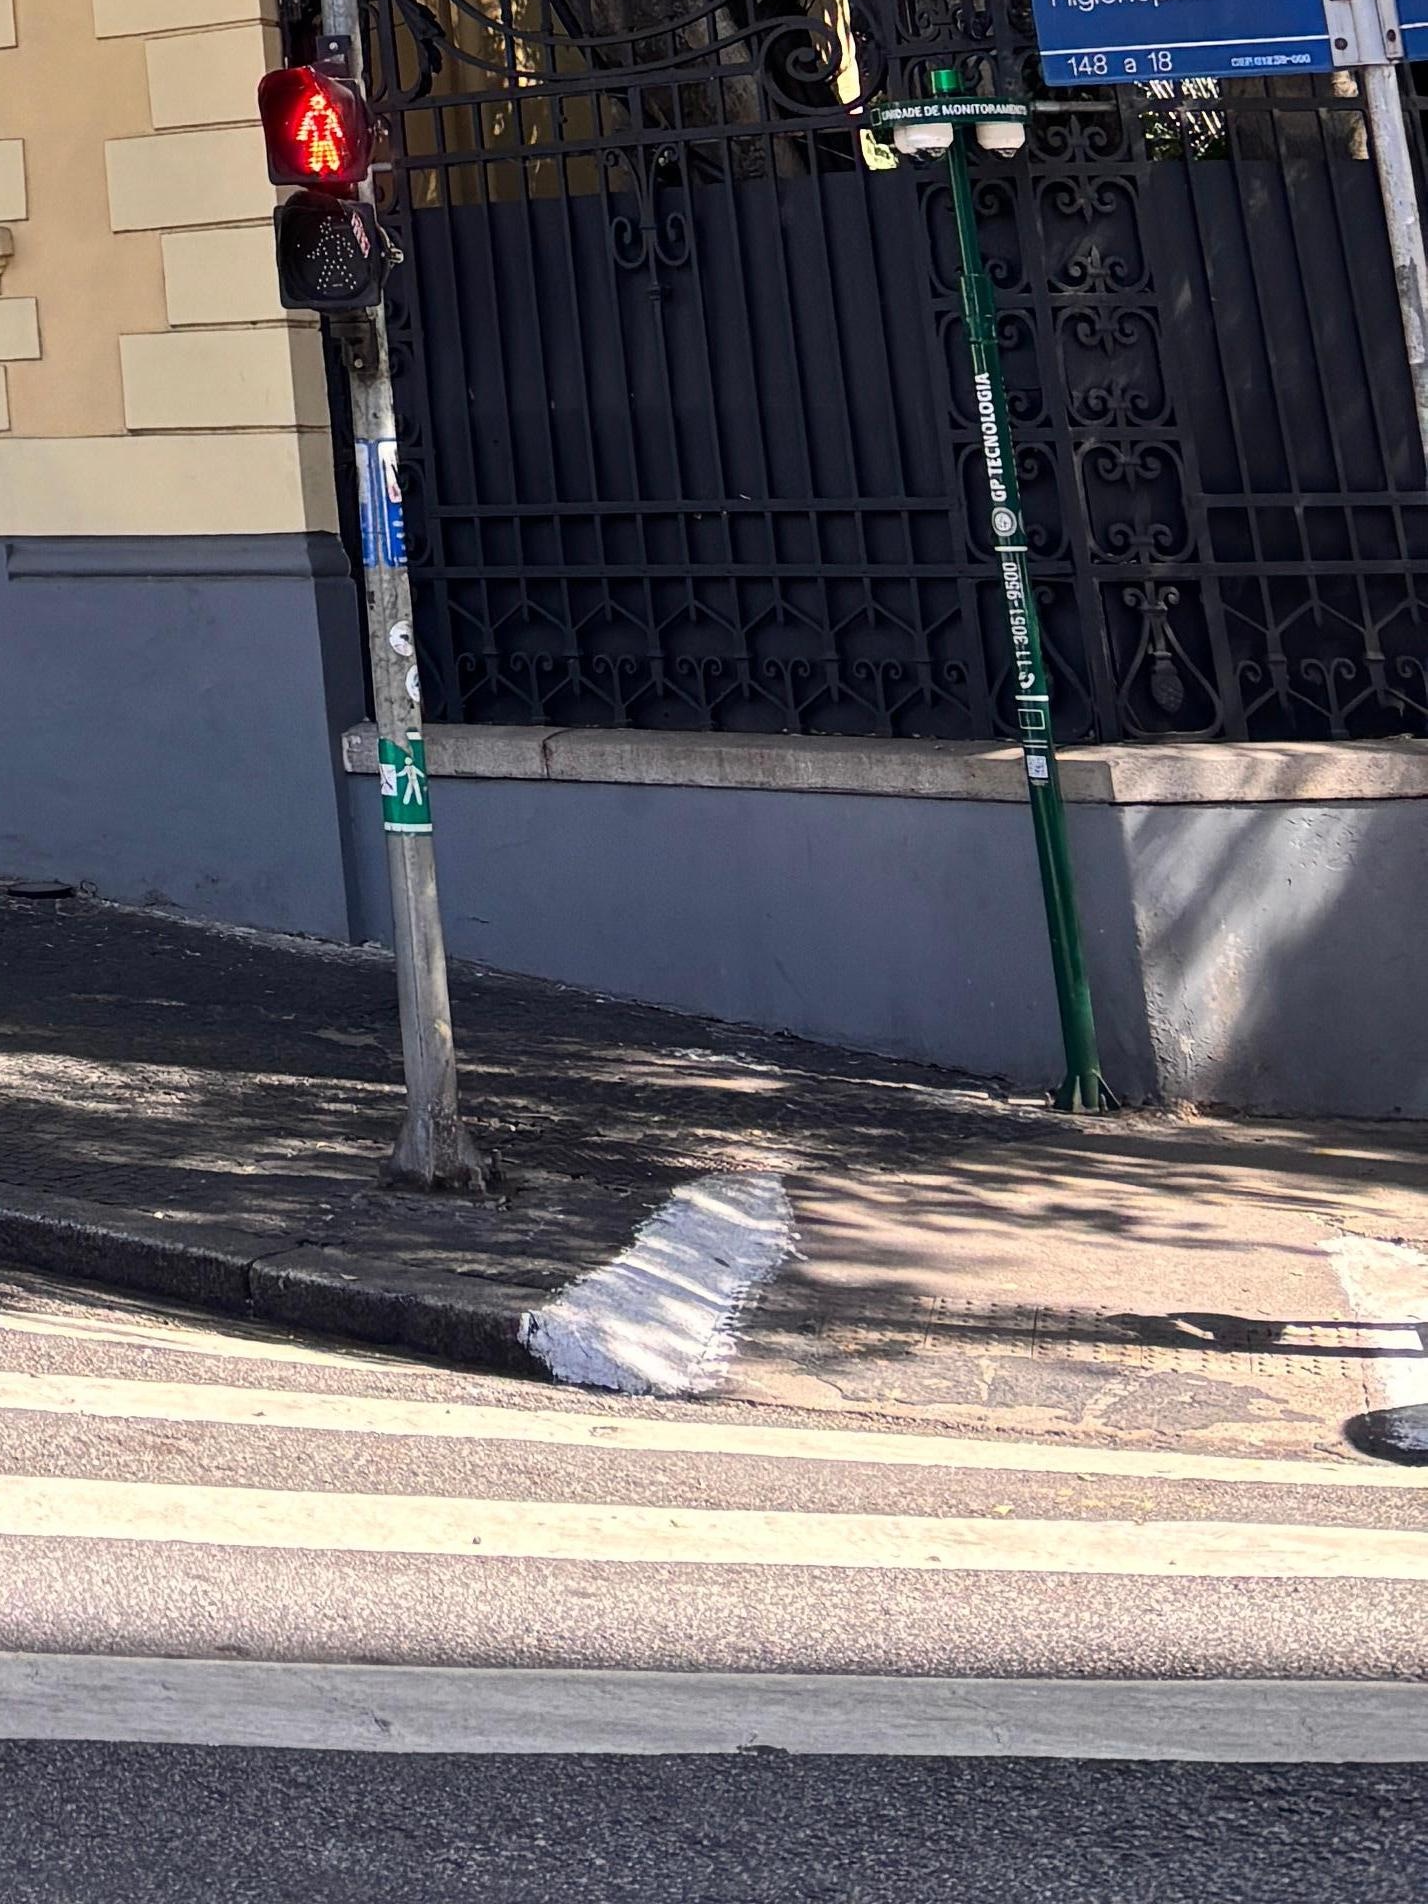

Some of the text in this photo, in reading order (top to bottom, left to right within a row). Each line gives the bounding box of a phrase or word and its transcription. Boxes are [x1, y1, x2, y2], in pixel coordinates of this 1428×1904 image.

[1067, 50, 1173, 77] 148 a 18
[881, 106, 923, 121] UNIDADE
[923, 104, 941, 117] DE
[974, 372, 1004, 479] TECNOLOGIA
[1001, 561, 1030, 646] 3051-9500
